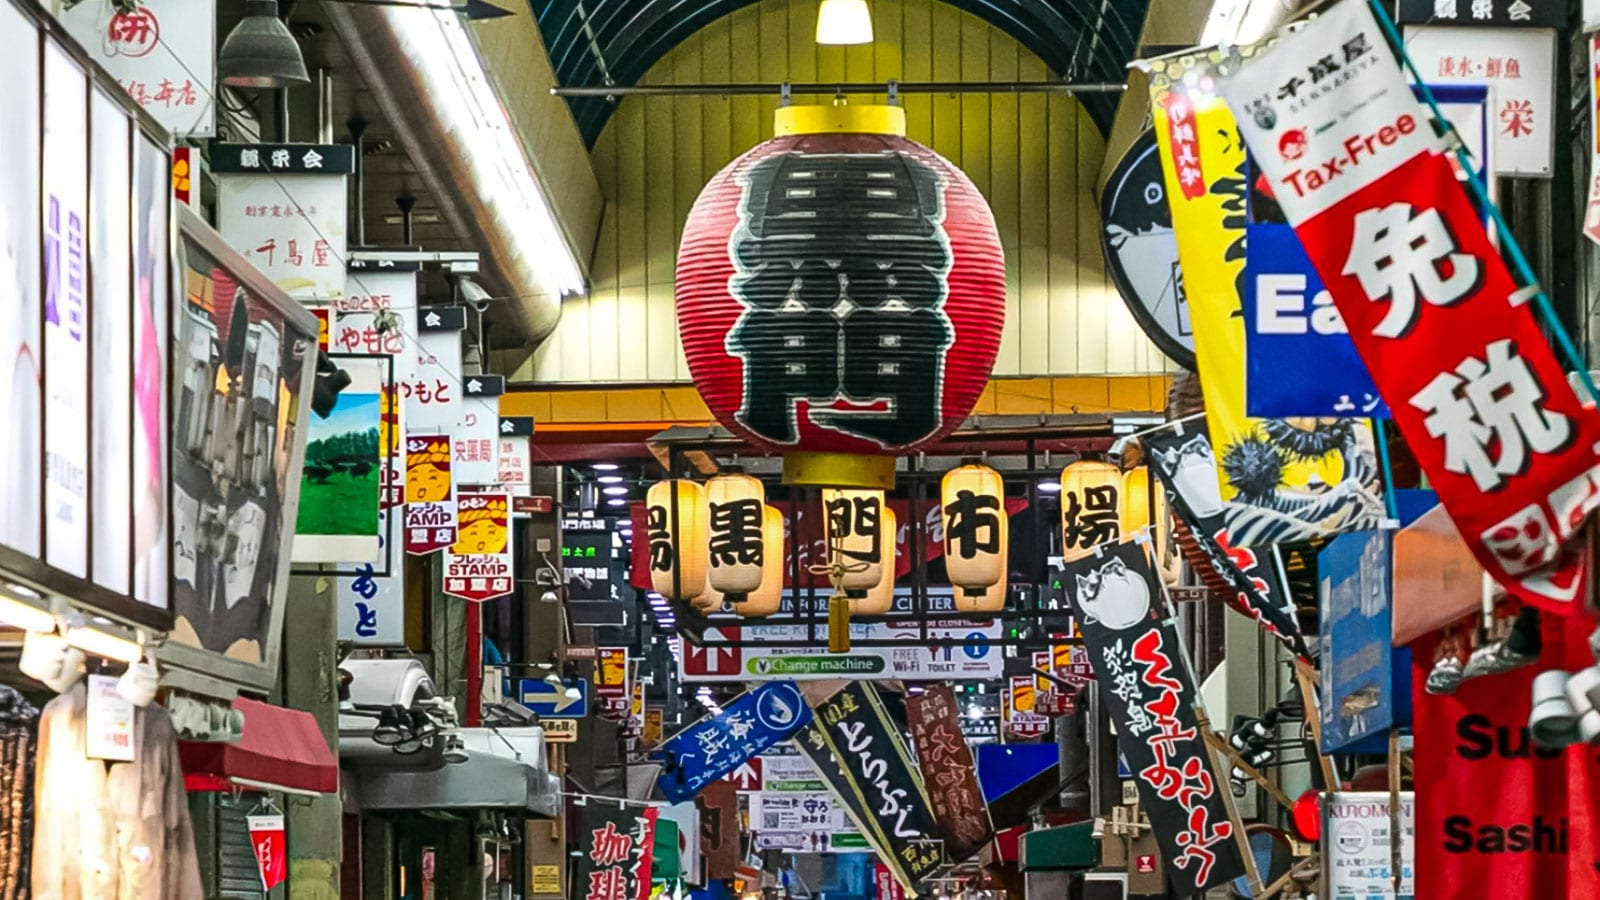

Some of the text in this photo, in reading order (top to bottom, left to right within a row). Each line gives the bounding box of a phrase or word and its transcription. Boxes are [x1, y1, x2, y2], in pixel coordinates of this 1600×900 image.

[1500, 99, 1534, 138] 栄
[1282, 114, 1416, 197] Tax-Free
[424, 311, 441, 327] 会
[1340, 202, 1570, 493] 免税
[407, 513, 451, 526] AMP
[710, 498, 763, 568] 黒
[825, 497, 881, 563] 門
[945, 490, 1000, 559] 市
[1064, 485, 1120, 549] 場
[448, 565, 507, 576] STAMP
[893, 649, 919, 660] FREE
[771, 658, 873, 672] Change machine
[893, 661, 919, 672] Wi-Fi
[927, 663, 956, 672] TOILET
[837, 722, 921, 838] とらふぐ
[1444, 815, 1567, 854] Sashi
